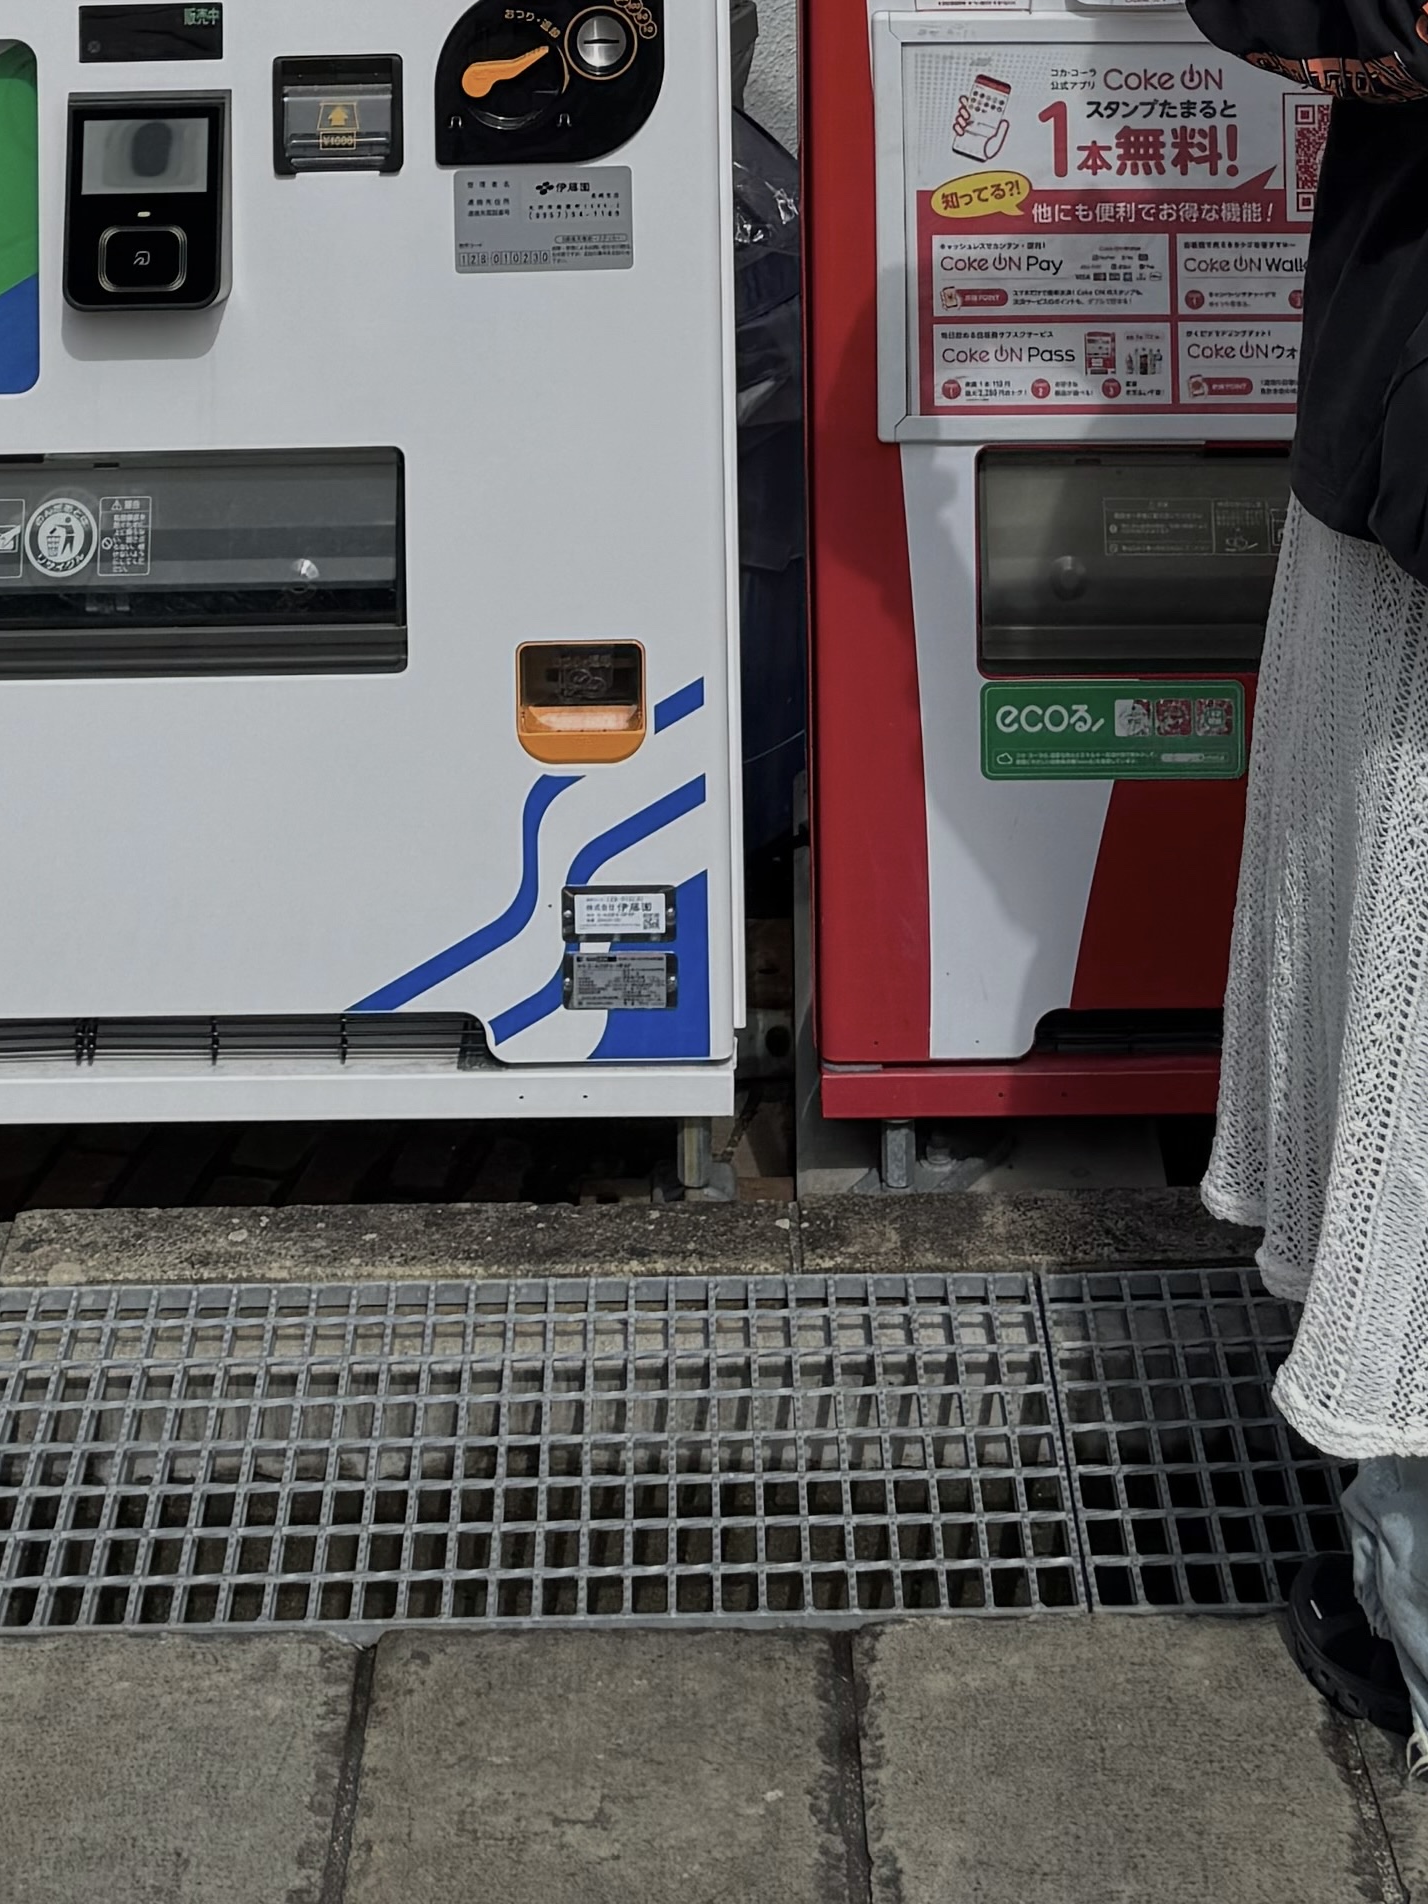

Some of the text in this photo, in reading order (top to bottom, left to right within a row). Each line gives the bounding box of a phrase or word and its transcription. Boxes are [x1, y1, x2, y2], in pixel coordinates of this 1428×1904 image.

[183, 6, 220, 27] 販売中
[1050, 81, 1096, 90] 公式アプリ
[1103, 68, 1175, 91] Coke
[1180, 63, 1223, 91] ON
[1086, 99, 1237, 119] スタンプたまると
[1038, 100, 1239, 178] 1本無料!
[1031, 201, 1274, 224] 他にも便利でお得な機能!
[940, 252, 1064, 276] Coke ON Pay
[1184, 257, 1230, 273] Coke
[1233, 253, 1262, 272] ON
[942, 343, 1076, 363] Coke ON Pass
[1187, 340, 1299, 360] Coke ON ウォ
